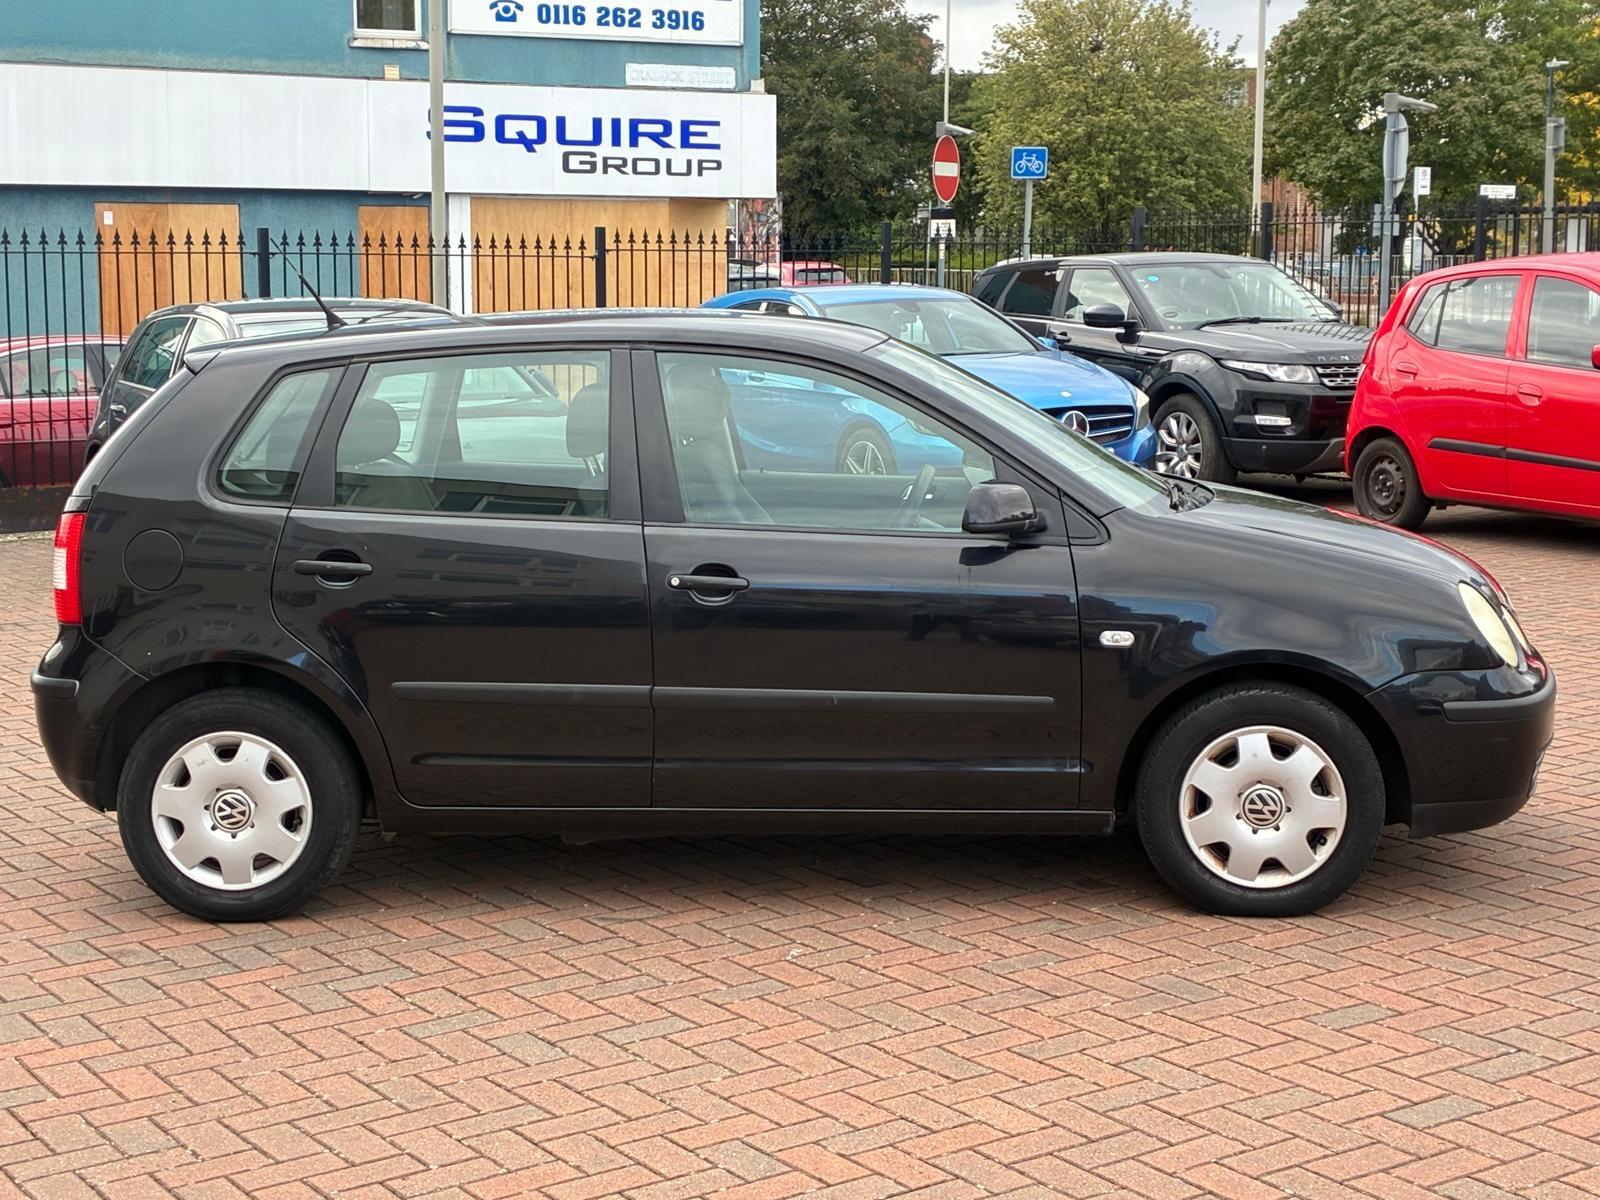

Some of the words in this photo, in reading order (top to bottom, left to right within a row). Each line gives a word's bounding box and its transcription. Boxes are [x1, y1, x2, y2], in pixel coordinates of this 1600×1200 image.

[537, 3, 585, 26] 0116
[596, 7, 641, 28] 262
[652, 10, 705, 31] 3916
[426, 105, 721, 153] SQUIRE
[562, 151, 722, 177] GROUP
